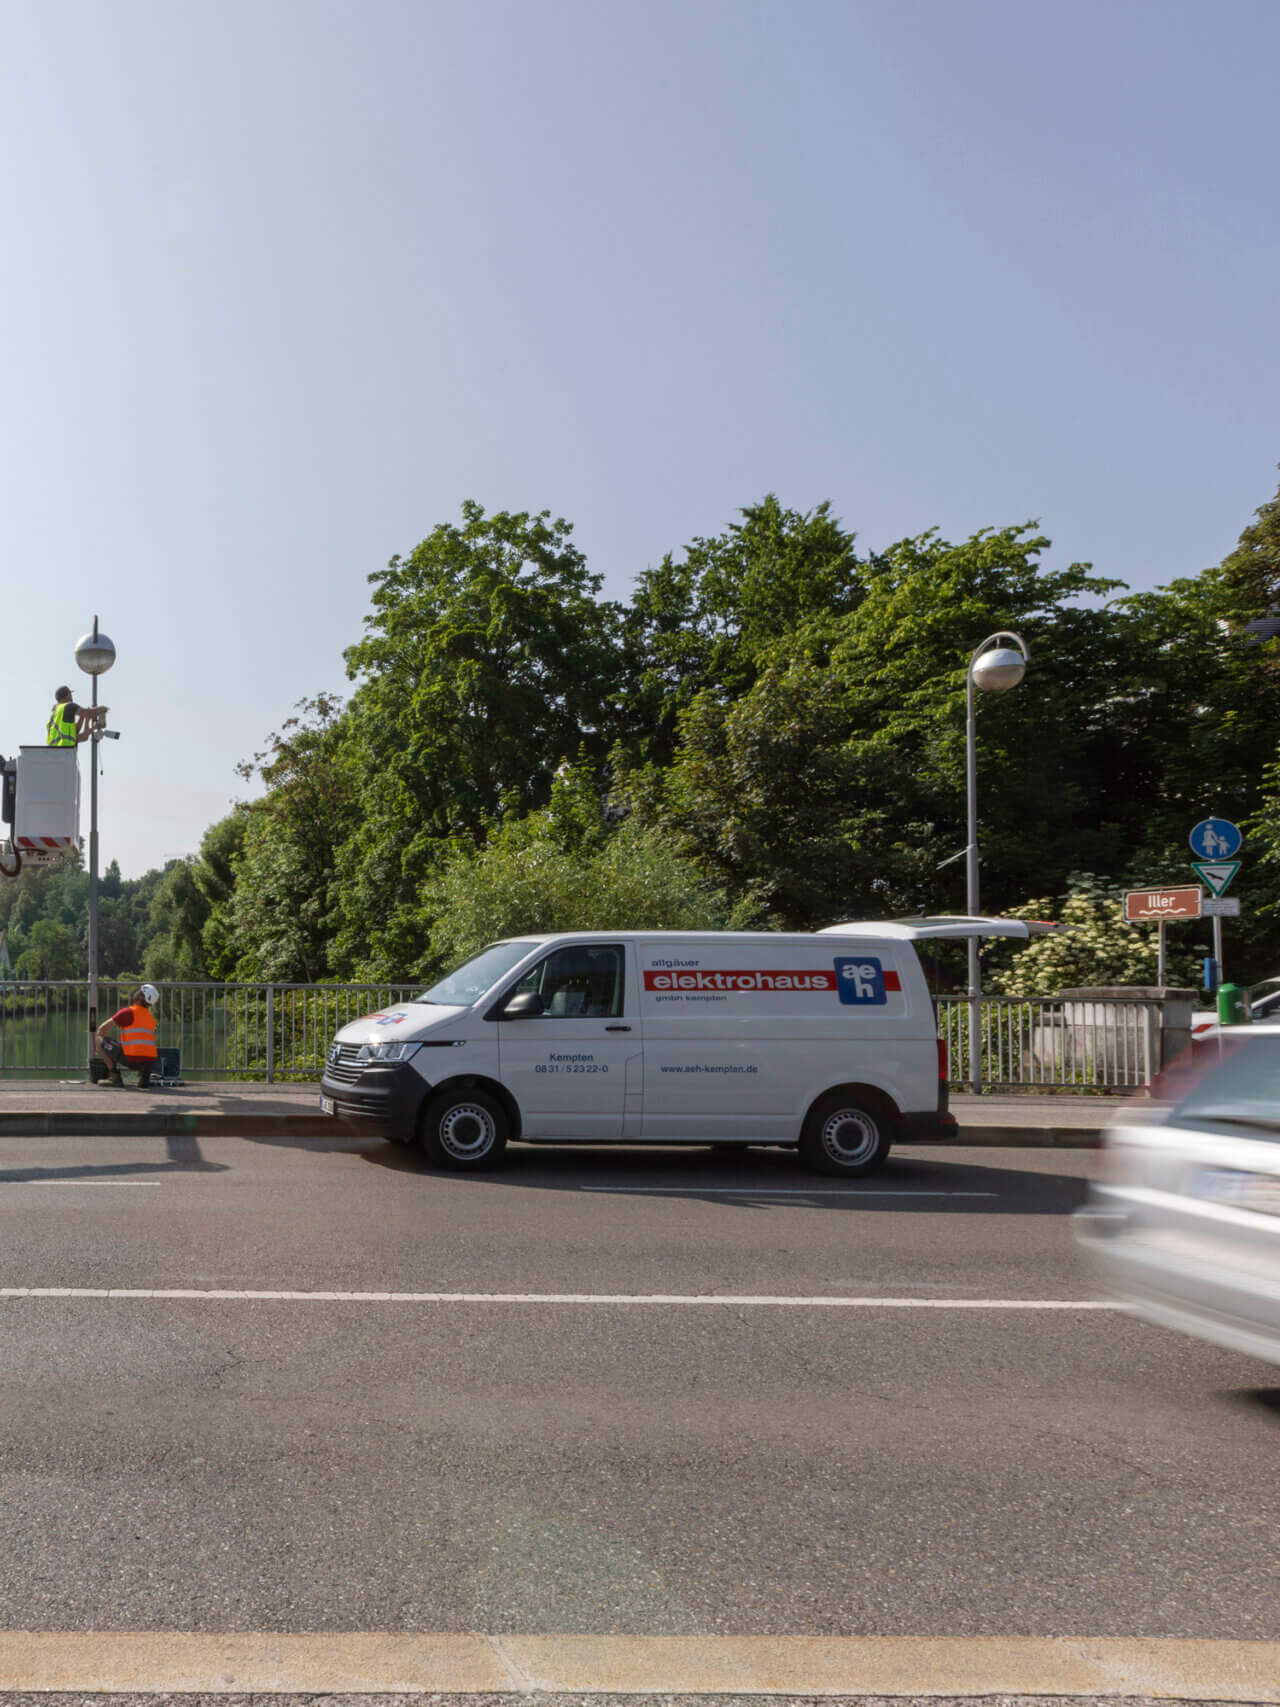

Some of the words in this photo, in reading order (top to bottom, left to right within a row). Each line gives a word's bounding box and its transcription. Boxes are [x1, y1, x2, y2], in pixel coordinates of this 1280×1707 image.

[1148, 895, 1176, 908] Iller
[651, 959, 700, 968] allgäuer
[653, 972, 829, 989] elektrohaus
[549, 1053, 594, 1064] Kempten
[660, 1064, 759, 1075] www.aeh-kempten.de
